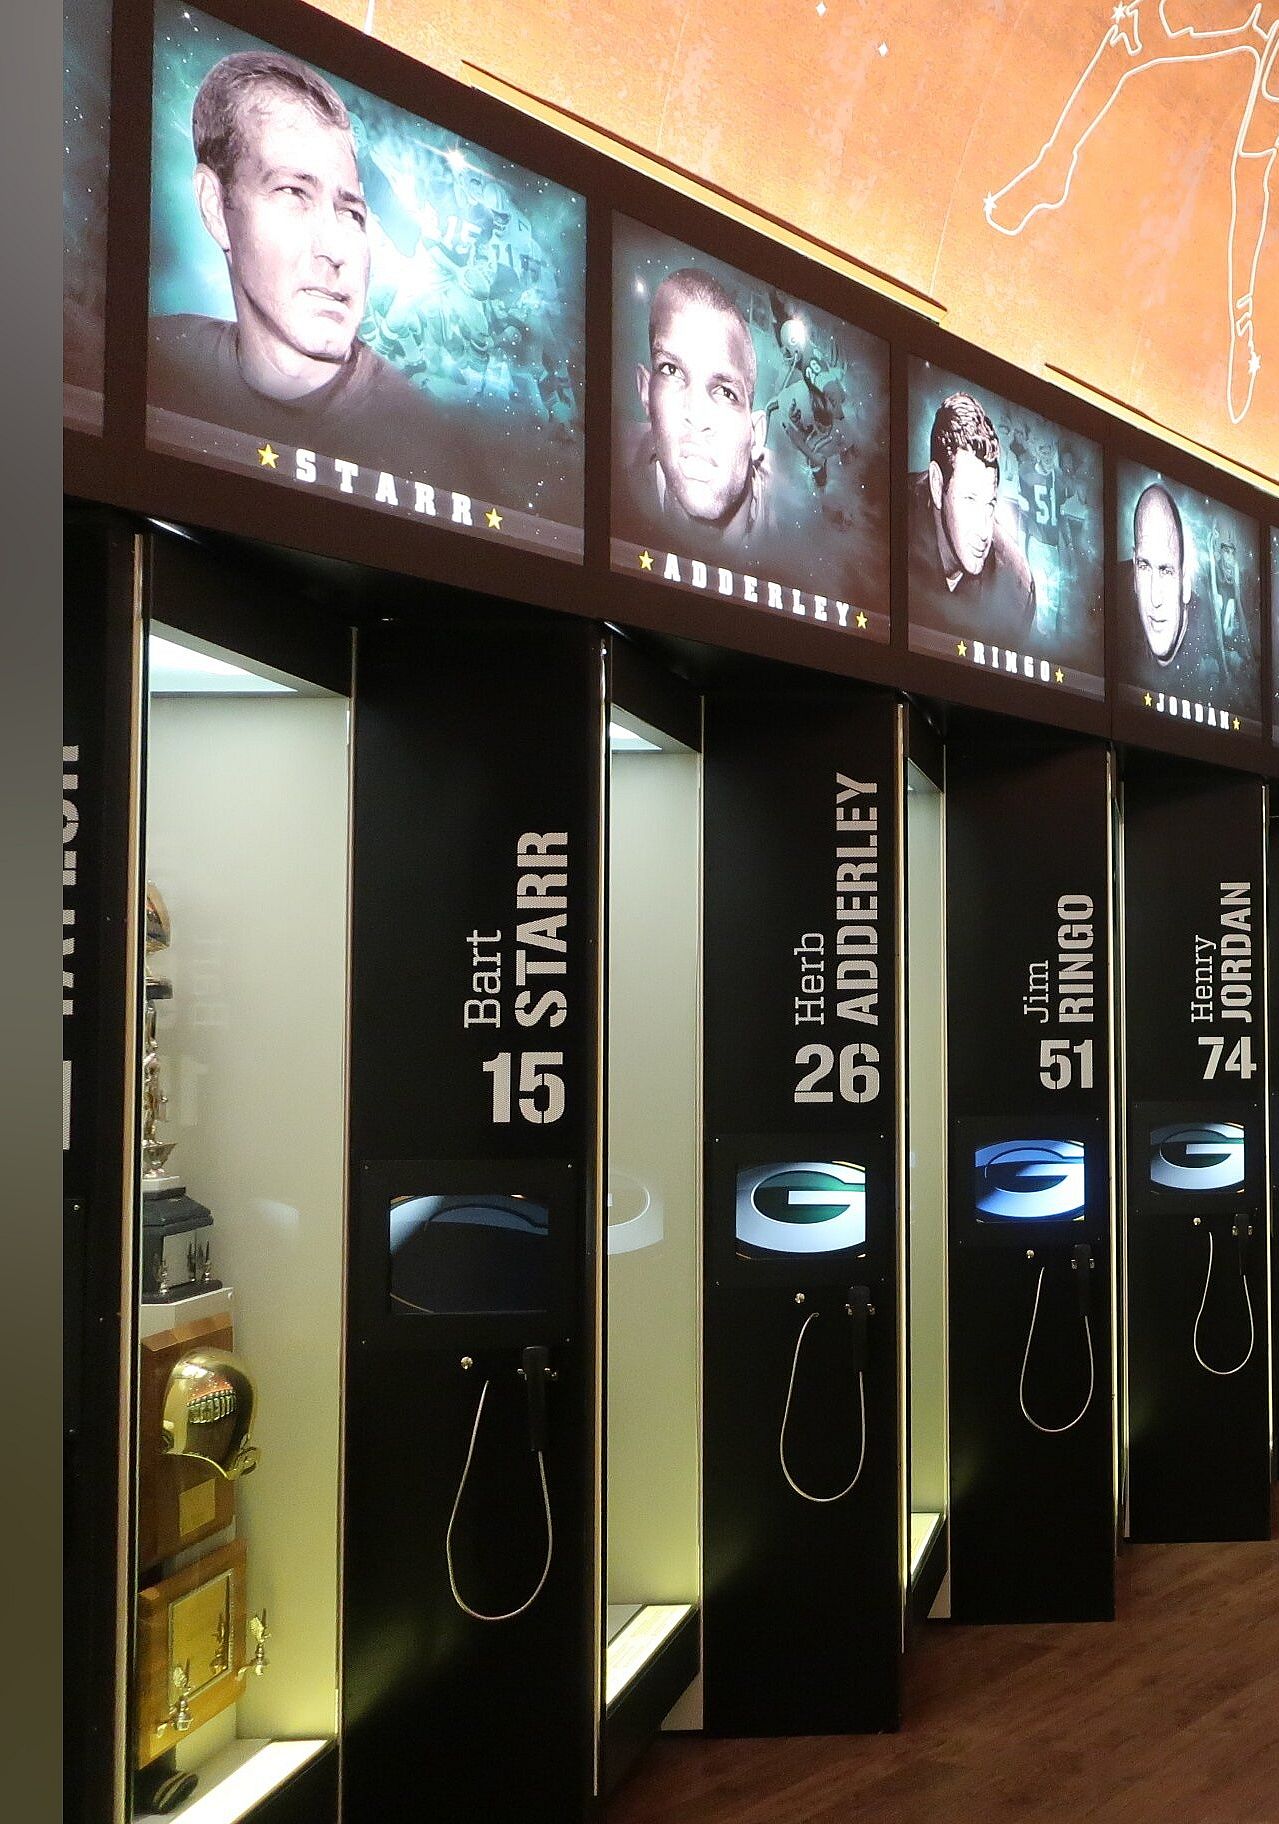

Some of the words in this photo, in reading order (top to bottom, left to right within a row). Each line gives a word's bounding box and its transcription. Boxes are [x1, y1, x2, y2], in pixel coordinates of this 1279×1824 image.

[295, 449, 472, 526] STARR
[664, 553, 849, 626] ADDERLEY
[973, 641, 1049, 681] RINGO
[1156, 693, 1229, 729] JORDAN
[515, 833, 567, 1027] STARR
[837, 773, 878, 1025] ADDERLEY
[464, 930, 501, 1028] Bart
[794, 933, 824, 1025] Herb
[1058, 895, 1093, 1022] RINGO
[1191, 935, 1216, 1022] Henry
[1221, 883, 1252, 1022] JORDAN
[1023, 960, 1048, 1023] Jim
[483, 1052, 565, 1123] 15
[794, 1043, 879, 1103] 26
[1040, 1040, 1093, 1089] 51
[1198, 1037, 1256, 1079] 74
